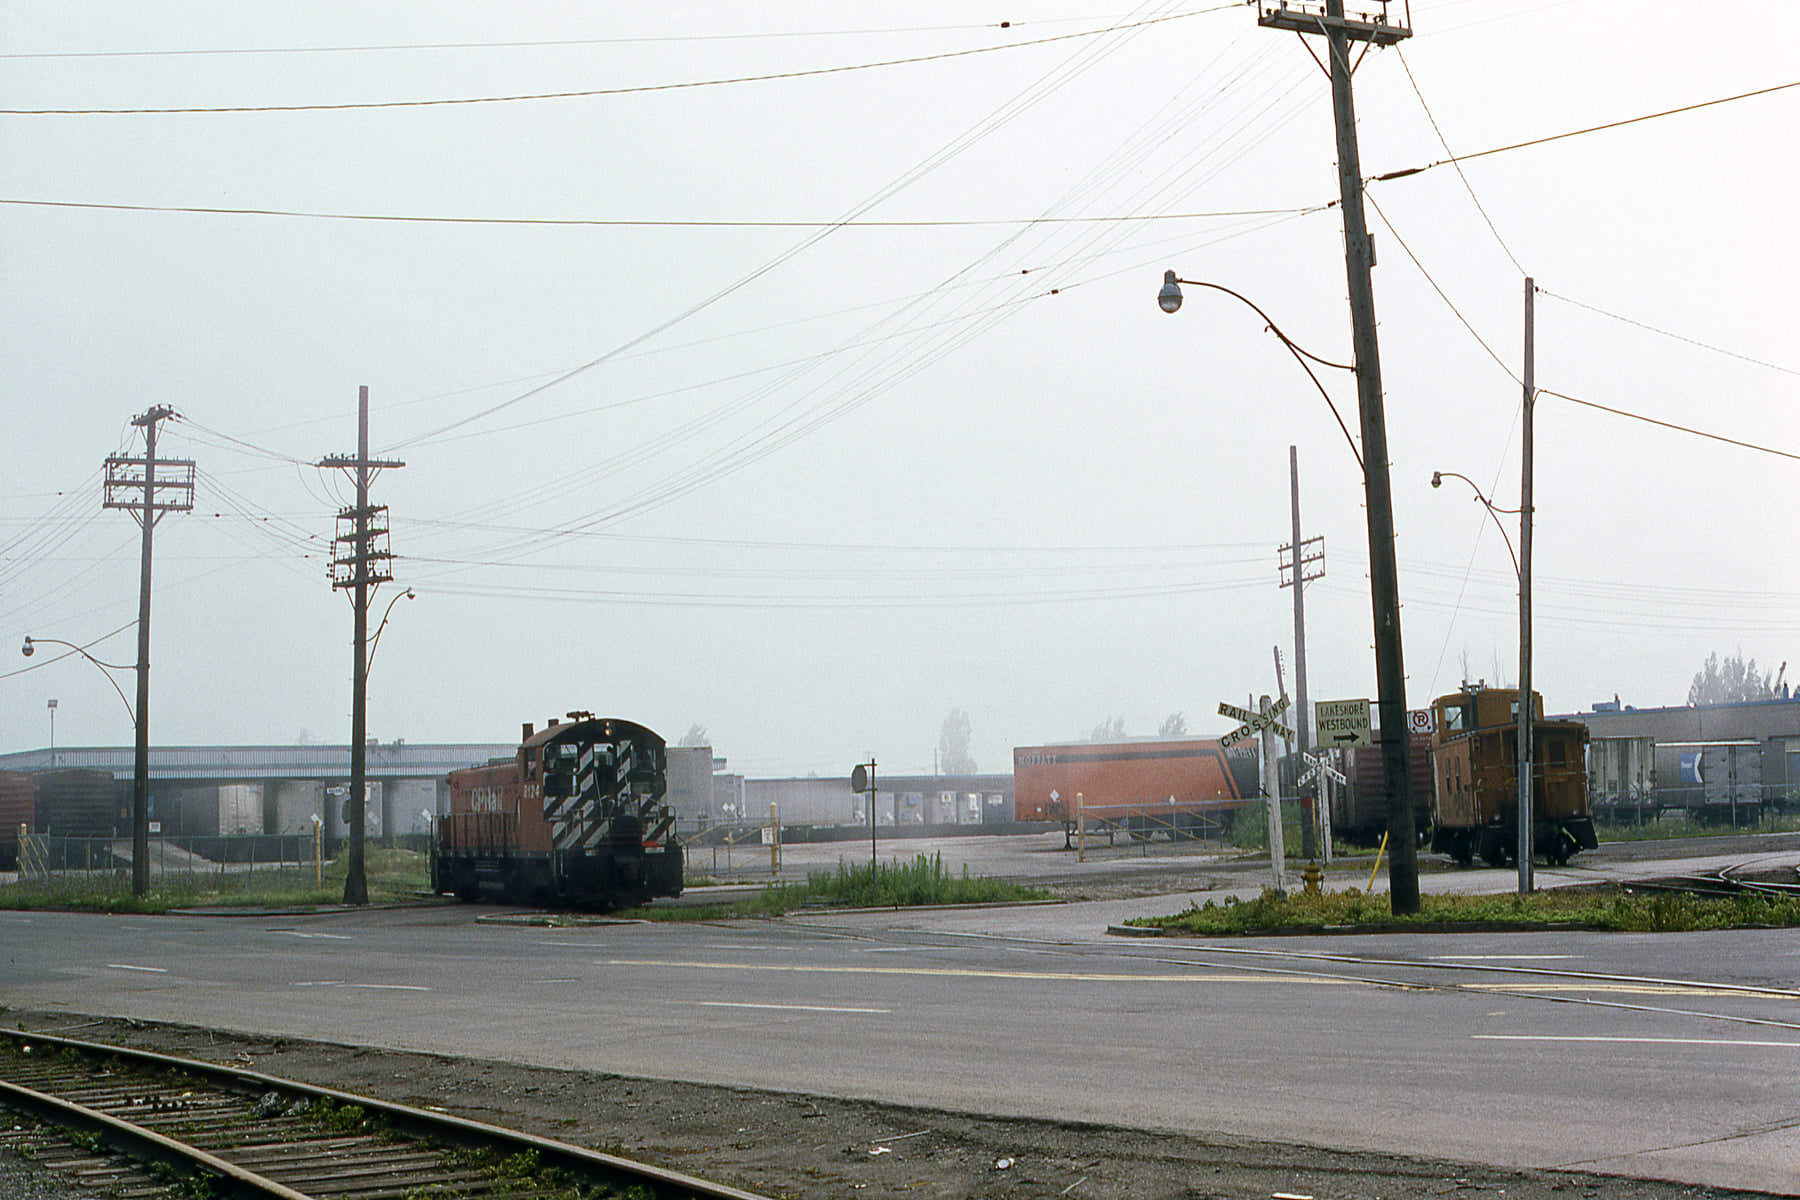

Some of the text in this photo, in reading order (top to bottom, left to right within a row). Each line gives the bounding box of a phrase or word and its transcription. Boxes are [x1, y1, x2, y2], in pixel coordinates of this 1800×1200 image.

[1320, 702, 1364, 716] LAKESHORE
[1221, 699, 1285, 747] CROSSING
[1319, 718, 1368, 731] WESTBOUND
